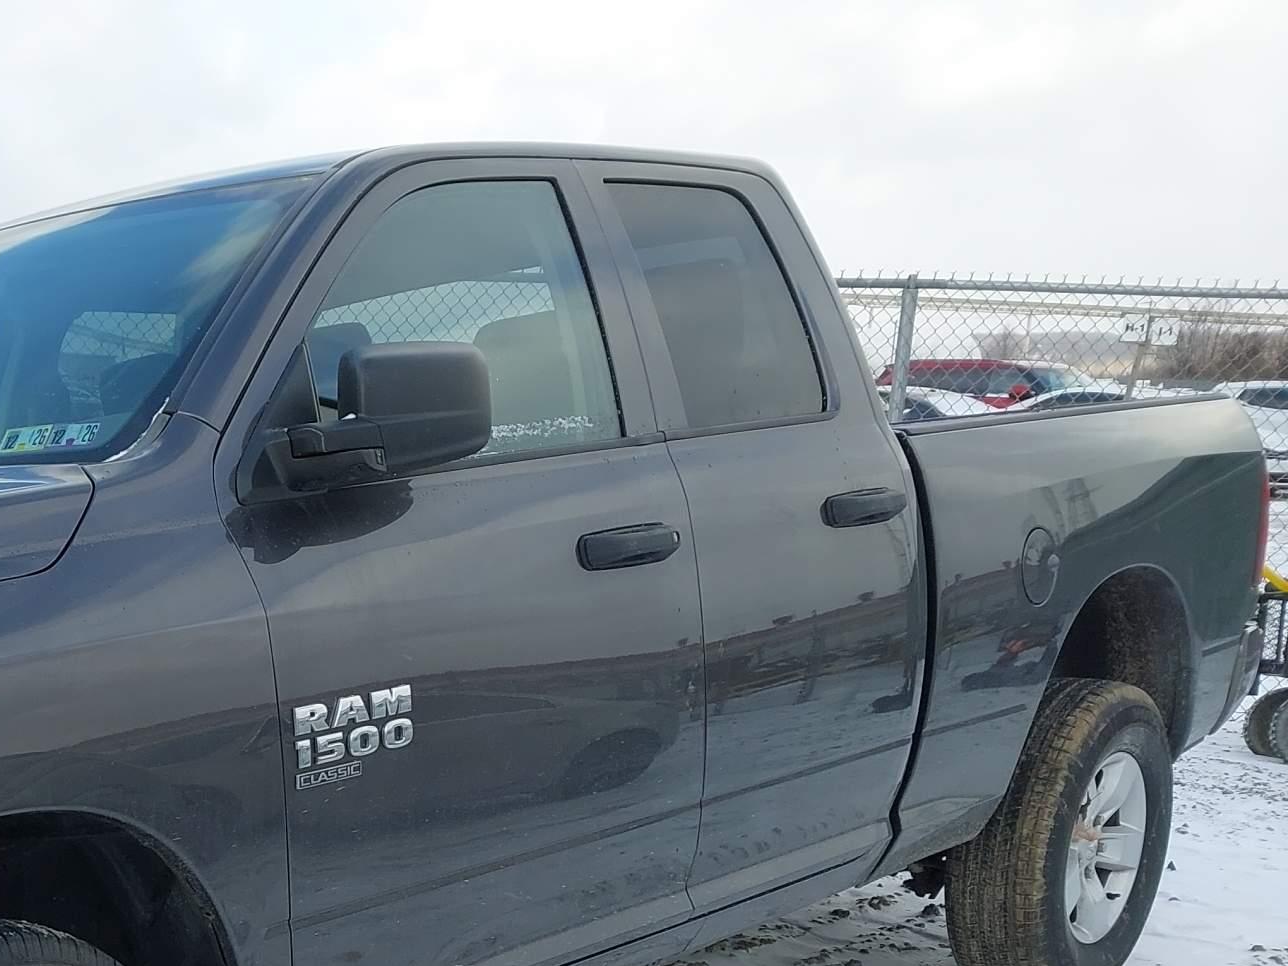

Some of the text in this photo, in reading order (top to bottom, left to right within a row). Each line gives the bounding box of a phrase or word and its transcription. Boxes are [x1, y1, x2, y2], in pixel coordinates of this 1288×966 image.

[3, 428, 48, 449] 12 26
[51, 425, 98, 445] 12 26
[293, 684, 413, 737] RAM
[295, 718, 414, 769] 1500
[300, 763, 361, 788] CLASSIC
